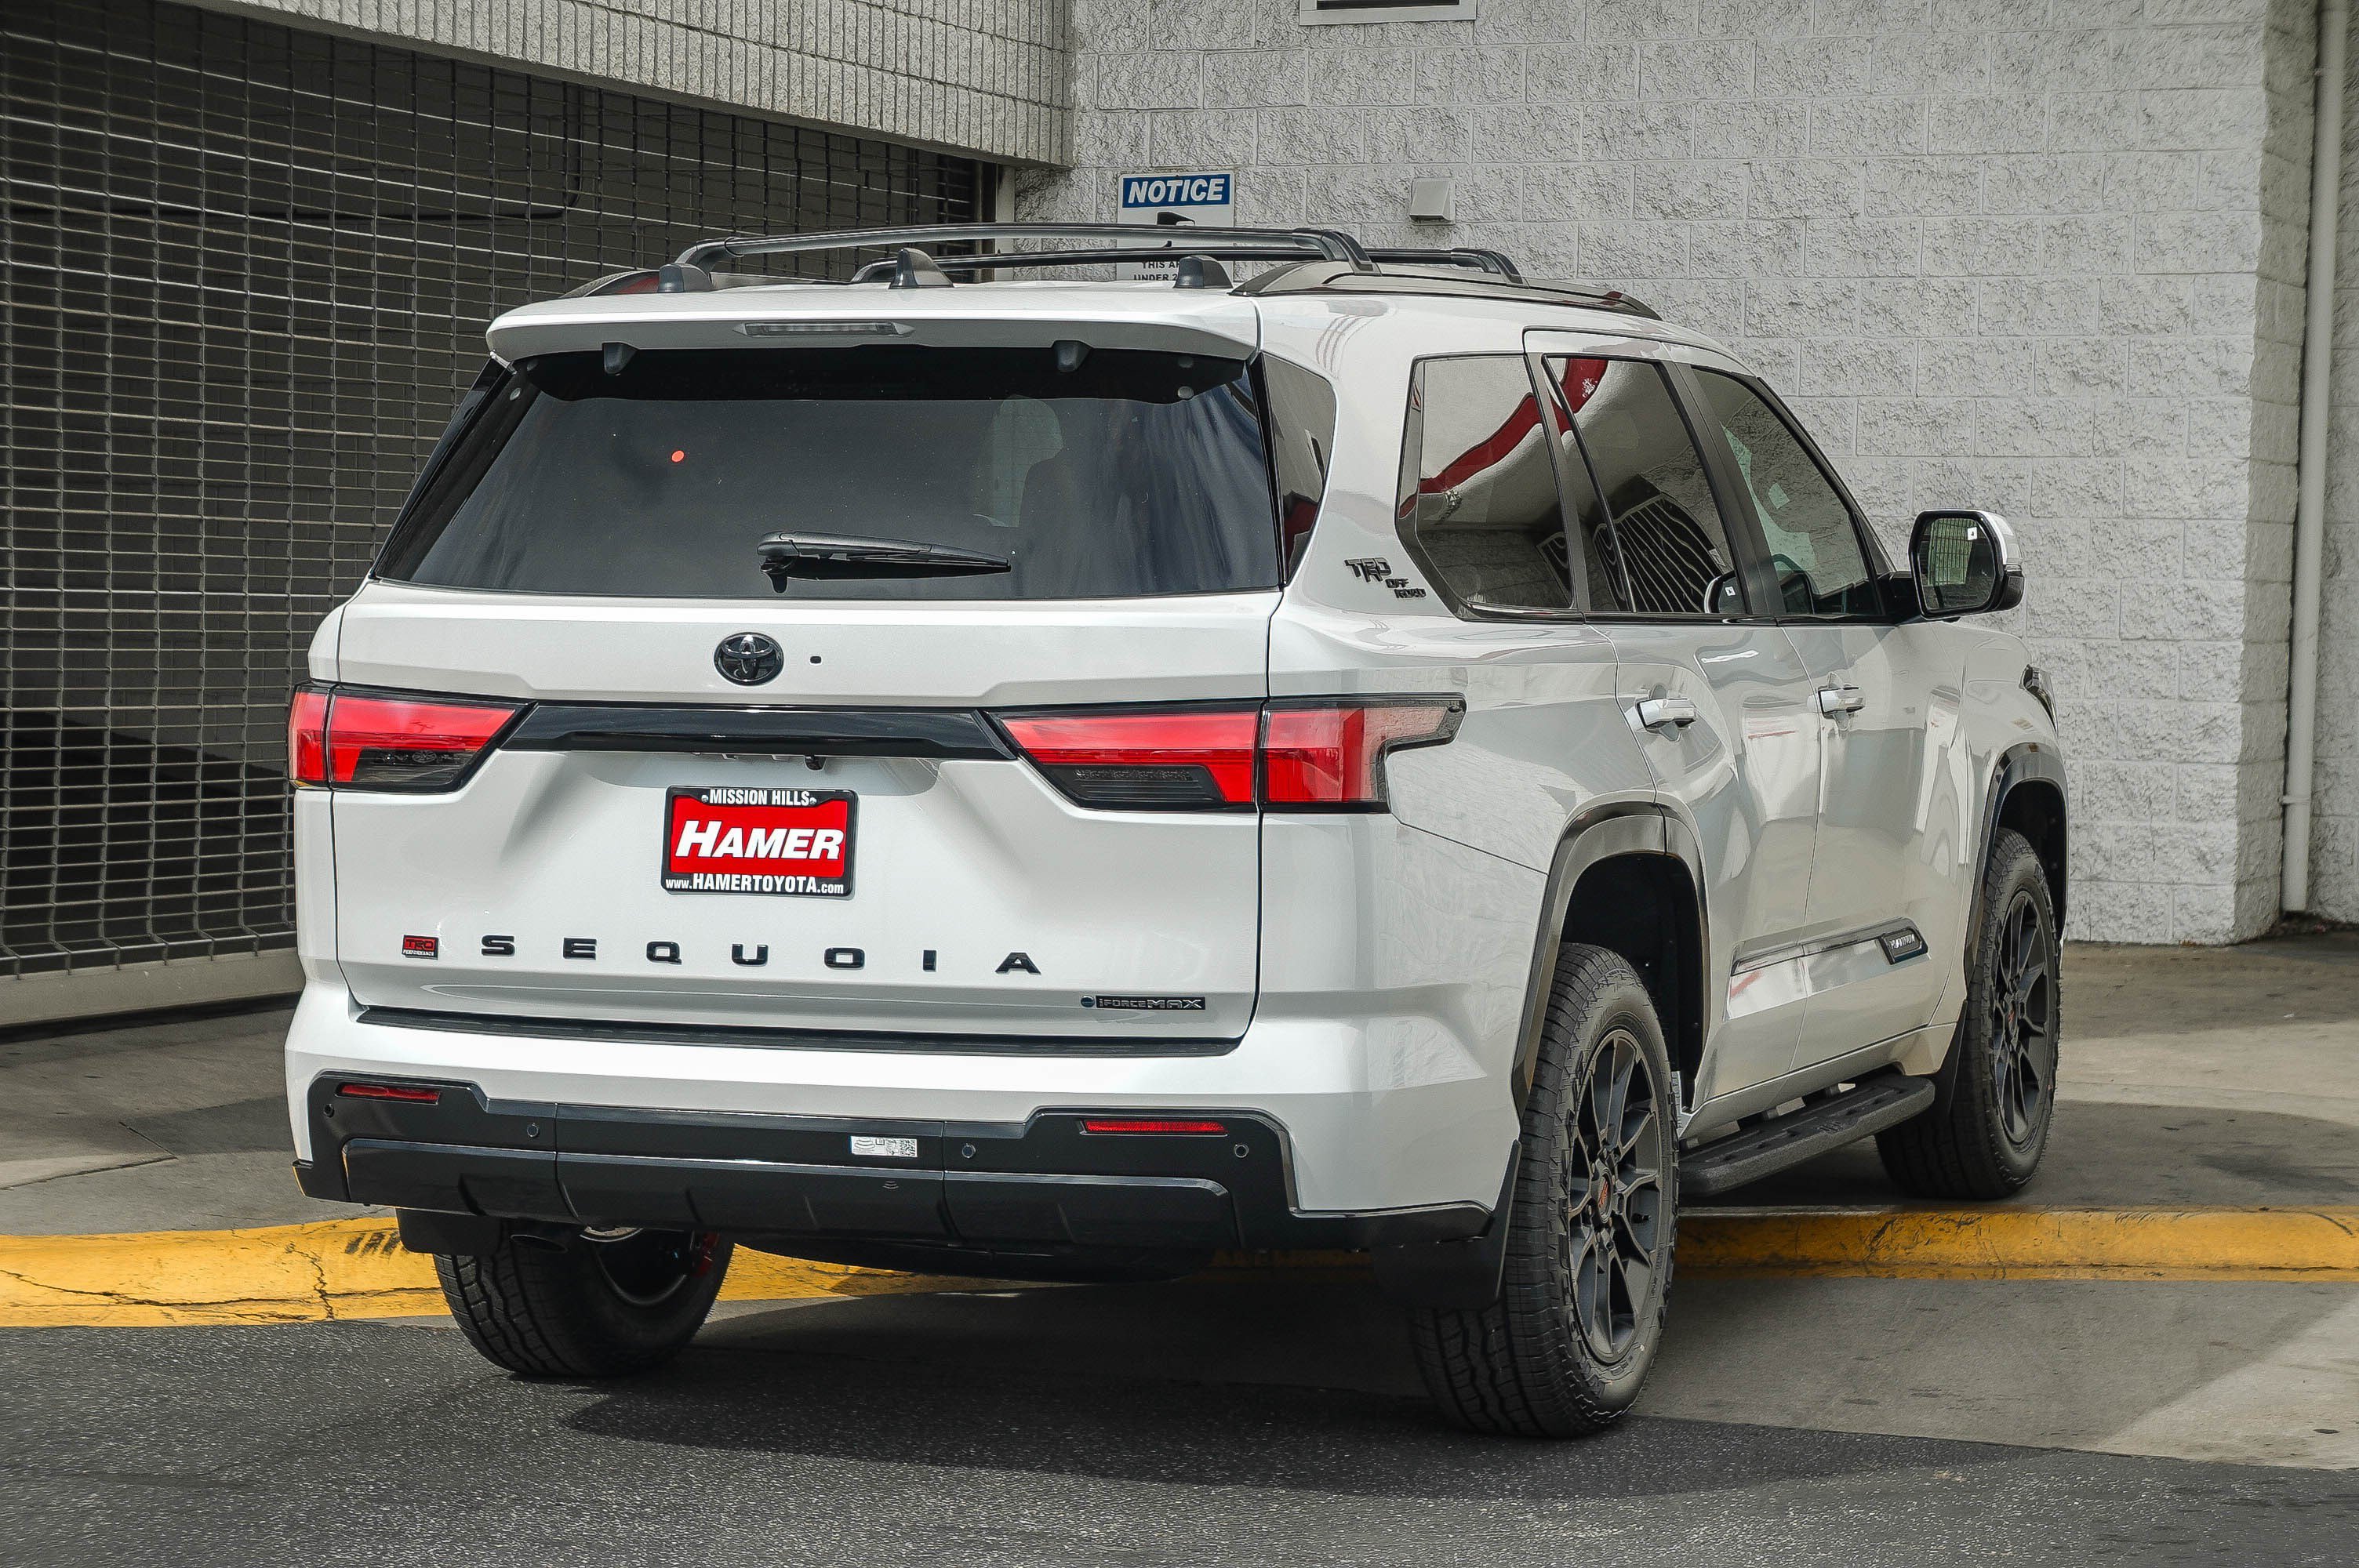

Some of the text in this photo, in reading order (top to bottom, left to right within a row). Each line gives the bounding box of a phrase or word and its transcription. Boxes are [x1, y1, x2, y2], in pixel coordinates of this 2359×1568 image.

[1128, 178, 1225, 204] NOTICE
[1142, 260, 1165, 269] THIS
[1343, 557, 1392, 583] TRD
[1385, 578, 1410, 589] OFF
[1394, 588, 1427, 599] ROAD
[709, 789, 810, 807] MISSION HILLS
[674, 819, 845, 860] HAMER
[665, 873, 845, 895] www.HAMERTOYOTA.com
[481, 935, 1042, 975] SEQUOIA
